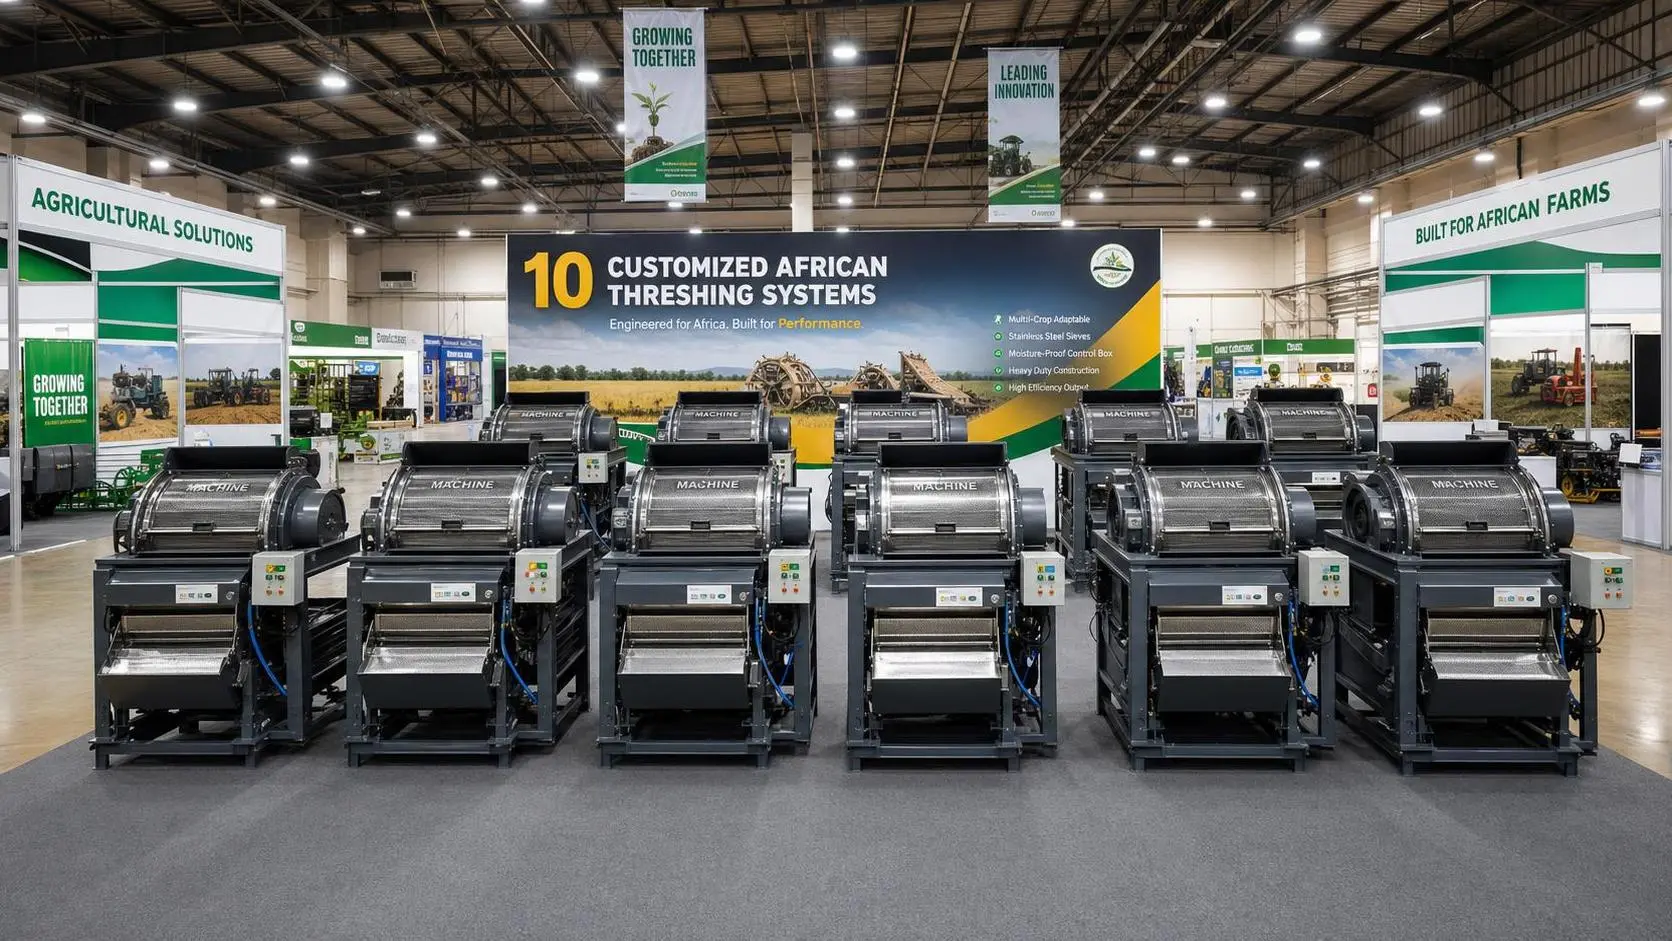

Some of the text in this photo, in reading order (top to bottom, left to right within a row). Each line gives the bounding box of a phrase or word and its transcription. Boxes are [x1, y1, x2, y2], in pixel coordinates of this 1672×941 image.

[632, 27, 693, 46] GROWING
[632, 48, 696, 67] TOGETHER
[1001, 64, 1047, 81] LEADING
[994, 83, 1055, 99] INNOVATION
[1415, 181, 1611, 245] BUILT FOR AFRICAN FARMS
[31, 187, 254, 253] AGRICULTURAL SOLUTIONS
[607, 256, 888, 278] CUSTOMIZED AFRICAN
[523, 251, 594, 309] 10
[607, 284, 877, 306] THRESHING SYSTEMS
[609, 317, 863, 333] Engineered for Africa. Built for Performance.
[1053, 315, 1091, 325] Adaptable
[1008, 332, 1091, 341] Stainless Steel Sieves
[1008, 349, 1113, 358] Moisture-Proof Control Box
[1008, 366, 1100, 376] Heavy Duty Construction
[33, 374, 85, 393] GROWING
[1008, 383, 1027, 393] High
[1028, 383, 1062, 392] Efficiency
[33, 395, 88, 417] TOGETHER
[695, 411, 739, 419] MACHINE
[1281, 408, 1327, 416] MACHINE
[186, 483, 249, 493] MACHINE
[431, 480, 495, 489] MACHINE
[676, 480, 740, 489] MACHINE
[913, 481, 978, 491] MACHINE
[1180, 480, 1245, 489] MACHINE
[1432, 480, 1499, 489] MACHINE
